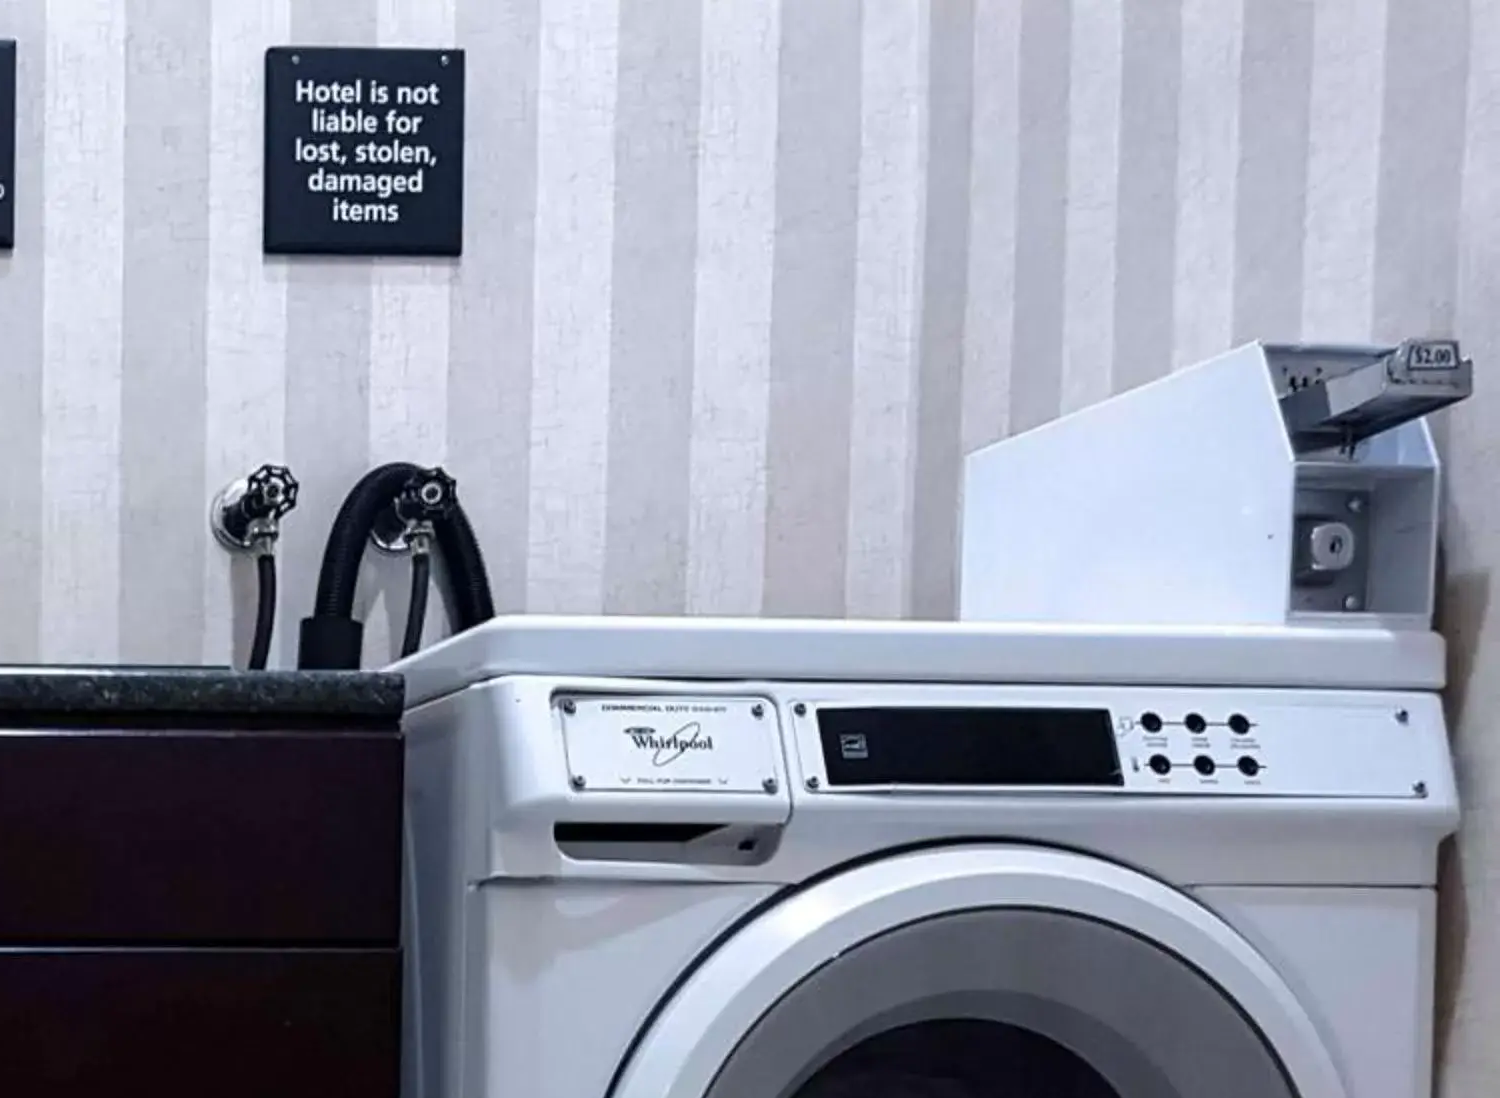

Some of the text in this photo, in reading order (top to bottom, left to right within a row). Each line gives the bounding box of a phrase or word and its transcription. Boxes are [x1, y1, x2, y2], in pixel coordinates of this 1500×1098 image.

[295, 79, 440, 105] Hotel is not
[312, 108, 423, 134] liable for
[295, 138, 437, 167] lost, stolen,
[308, 168, 424, 199] damaged
[332, 198, 399, 223] items
[631, 734, 713, 752] Whirlpool
